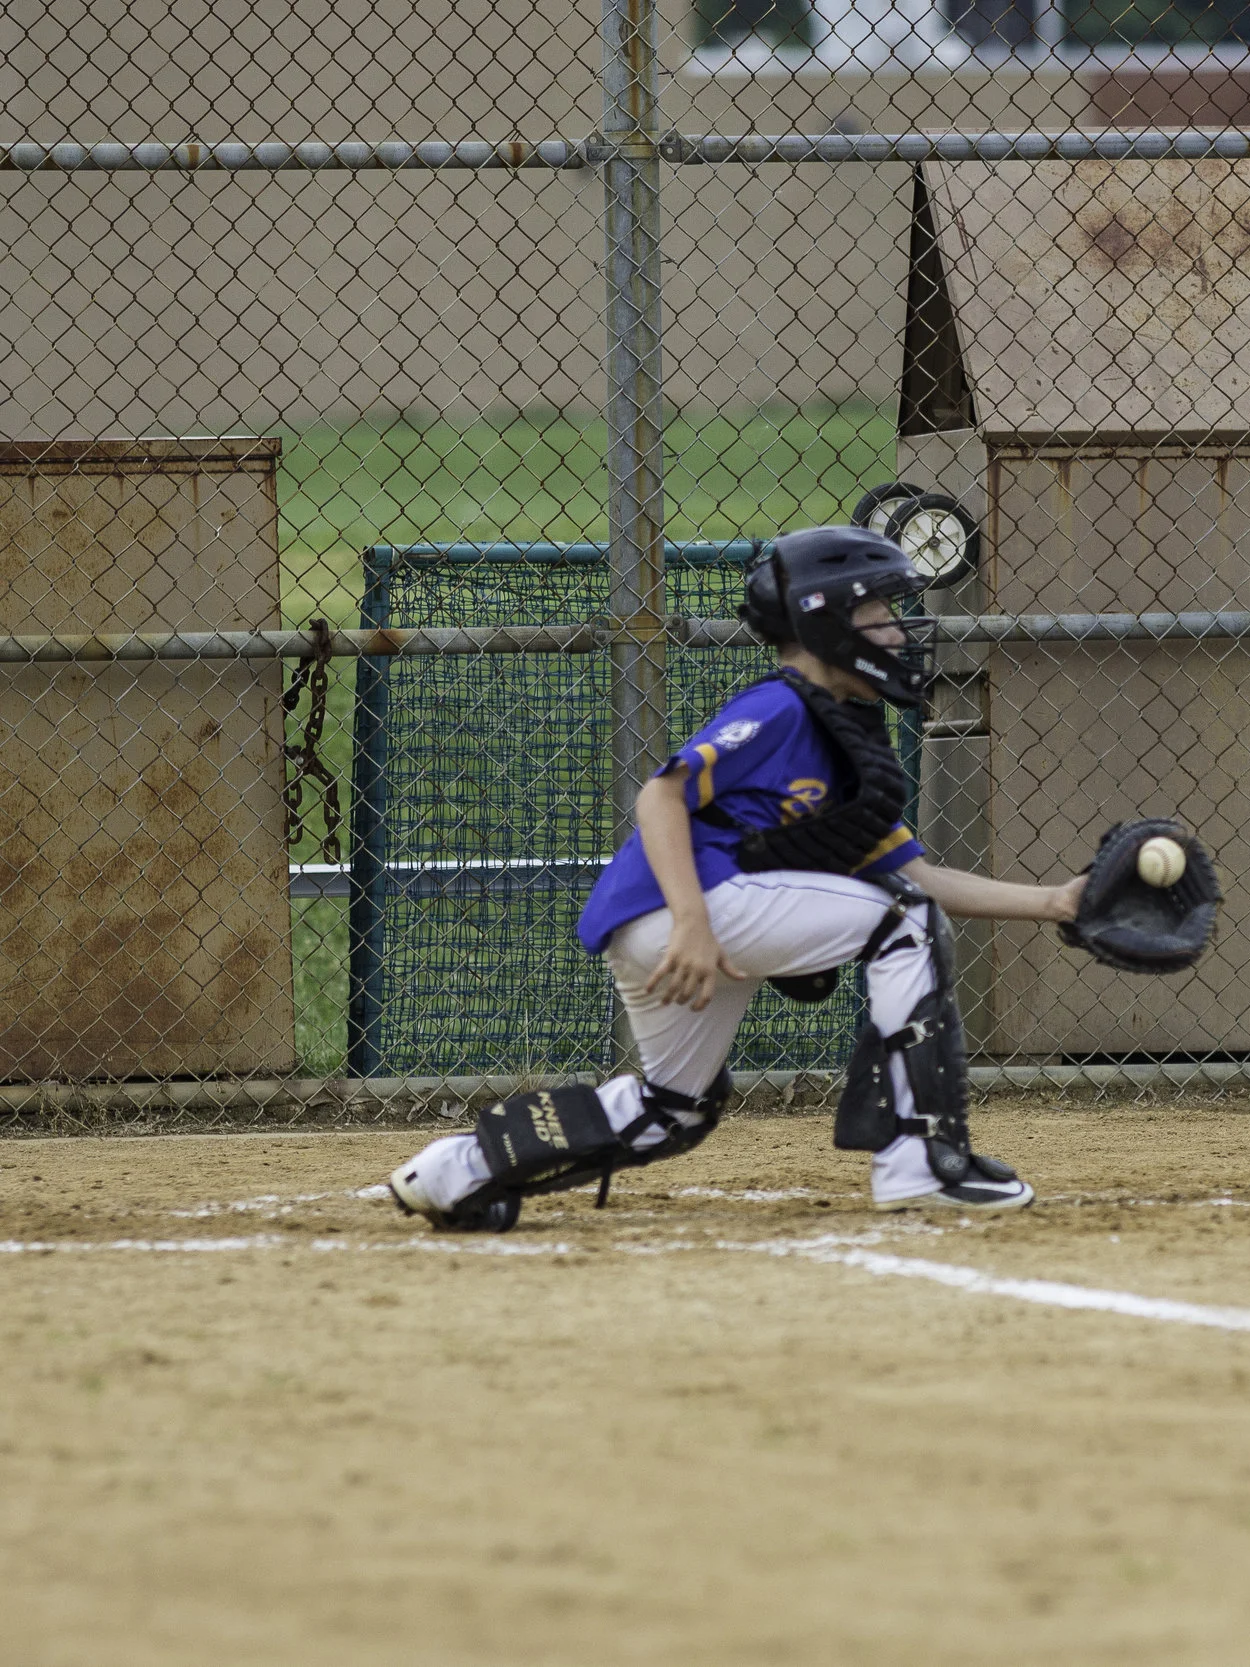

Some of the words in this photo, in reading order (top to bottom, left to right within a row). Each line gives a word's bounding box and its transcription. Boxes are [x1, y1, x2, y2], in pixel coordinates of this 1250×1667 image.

[854, 657, 889, 681] Wilson
[527, 1104, 552, 1142] AID
[537, 1091, 569, 1149] KNEE
